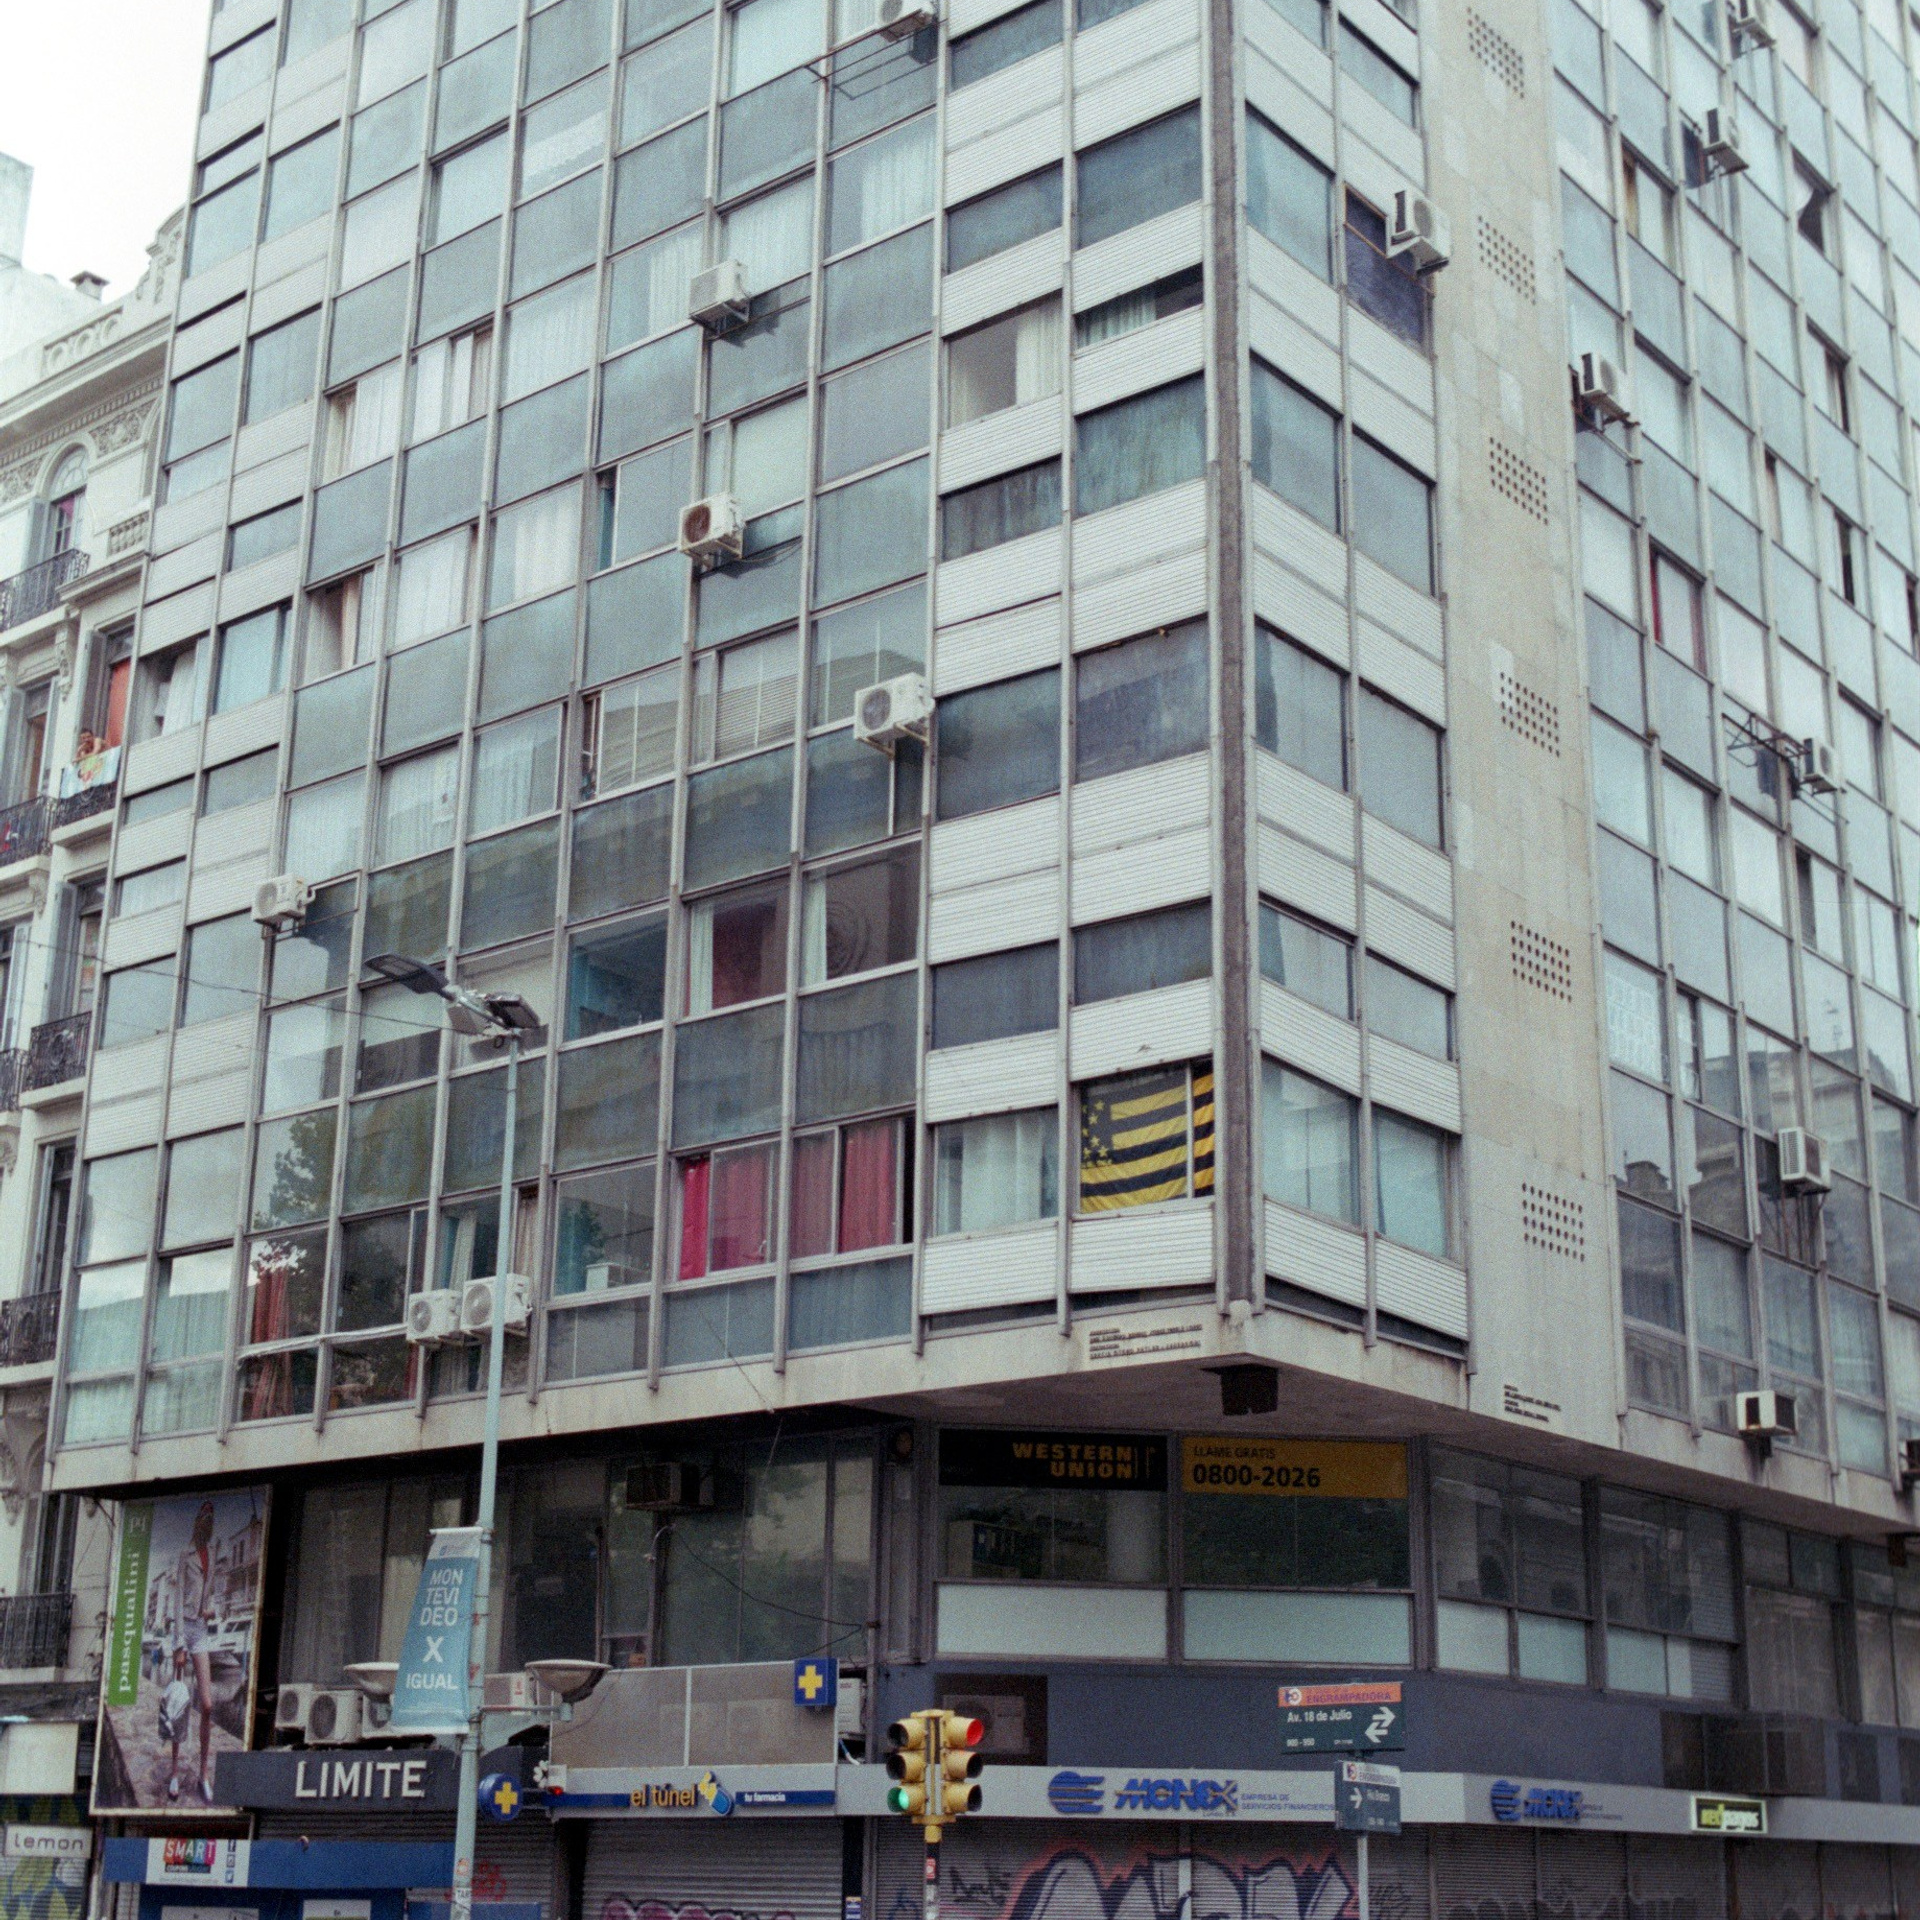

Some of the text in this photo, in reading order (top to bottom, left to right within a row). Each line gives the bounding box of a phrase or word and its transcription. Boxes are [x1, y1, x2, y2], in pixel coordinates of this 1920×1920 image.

[1012, 1442, 1132, 1462] WESTERN
[1193, 1445, 1276, 1460] LLAME GRATIS
[1050, 1459, 1132, 1479] UNION
[1192, 1464, 1322, 1489] 0800-2026
[429, 1568, 464, 1586] MON
[426, 1587, 460, 1606] TEVI
[118, 1551, 140, 1692] pasqualini
[419, 1606, 459, 1627] DEO
[422, 1635, 444, 1663] X
[405, 1672, 459, 1690] IGUAL
[1287, 1708, 1353, 1723] Av. 18 de Julio
[295, 1760, 427, 1798] LIMITE
[631, 1783, 697, 1807] el túnel
[754, 1792, 786, 1802] farmacia
[166, 1838, 216, 1860] SMART
